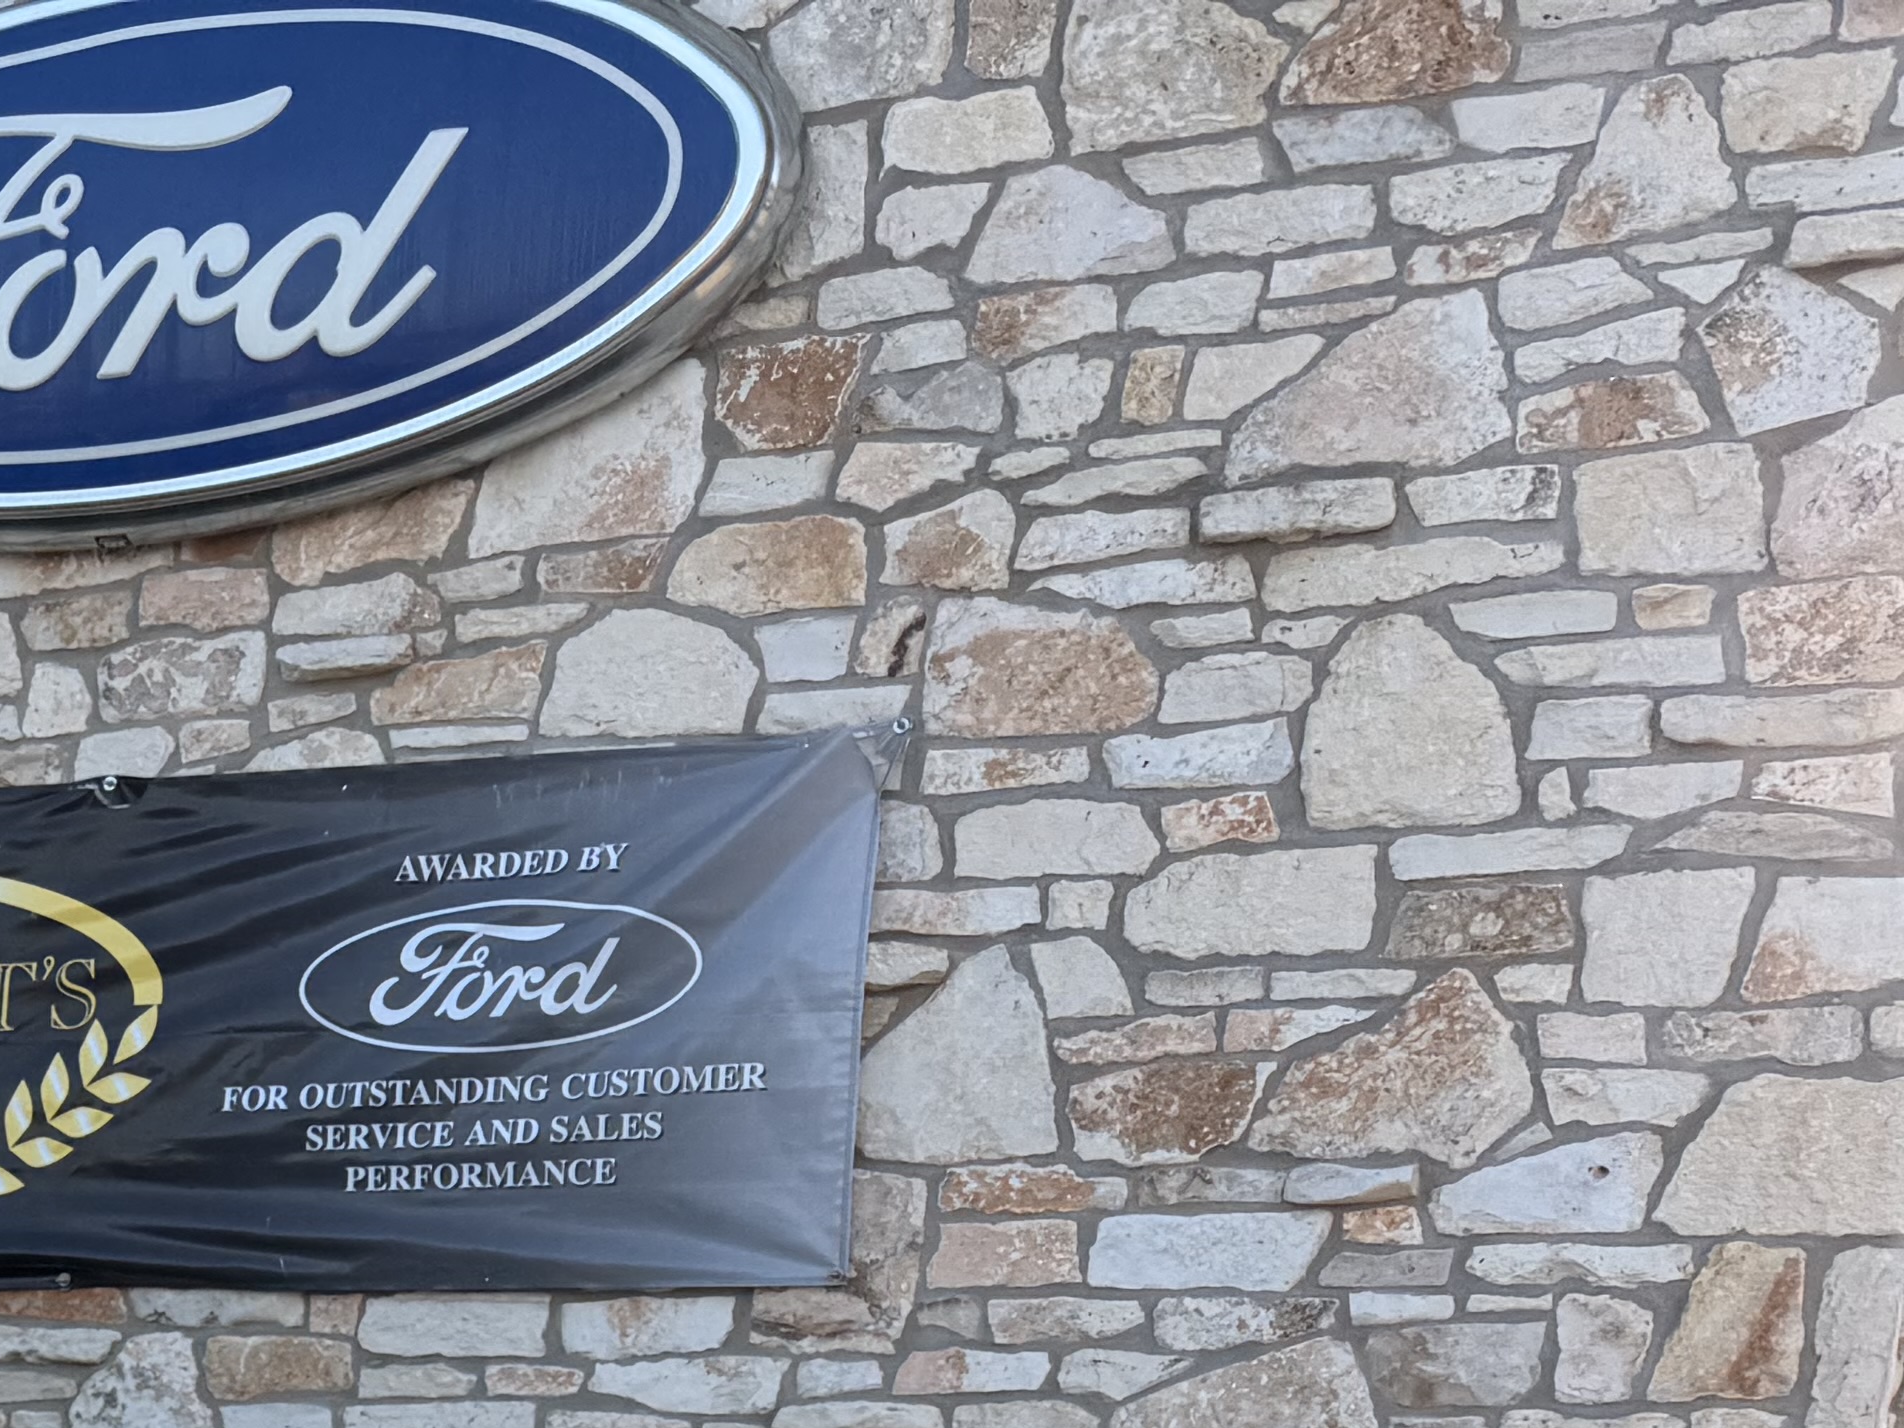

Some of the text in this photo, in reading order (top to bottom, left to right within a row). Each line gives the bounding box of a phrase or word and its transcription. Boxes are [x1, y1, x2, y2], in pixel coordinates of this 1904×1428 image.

[394, 843, 629, 884] AWARDED BY
[369, 921, 619, 1026] Ford
[221, 1061, 767, 1113] FOR OUTSTANDING CUSTOMER
[304, 1111, 664, 1152] SERVICE AND SALES
[344, 1157, 617, 1193] PERFORMANCE
